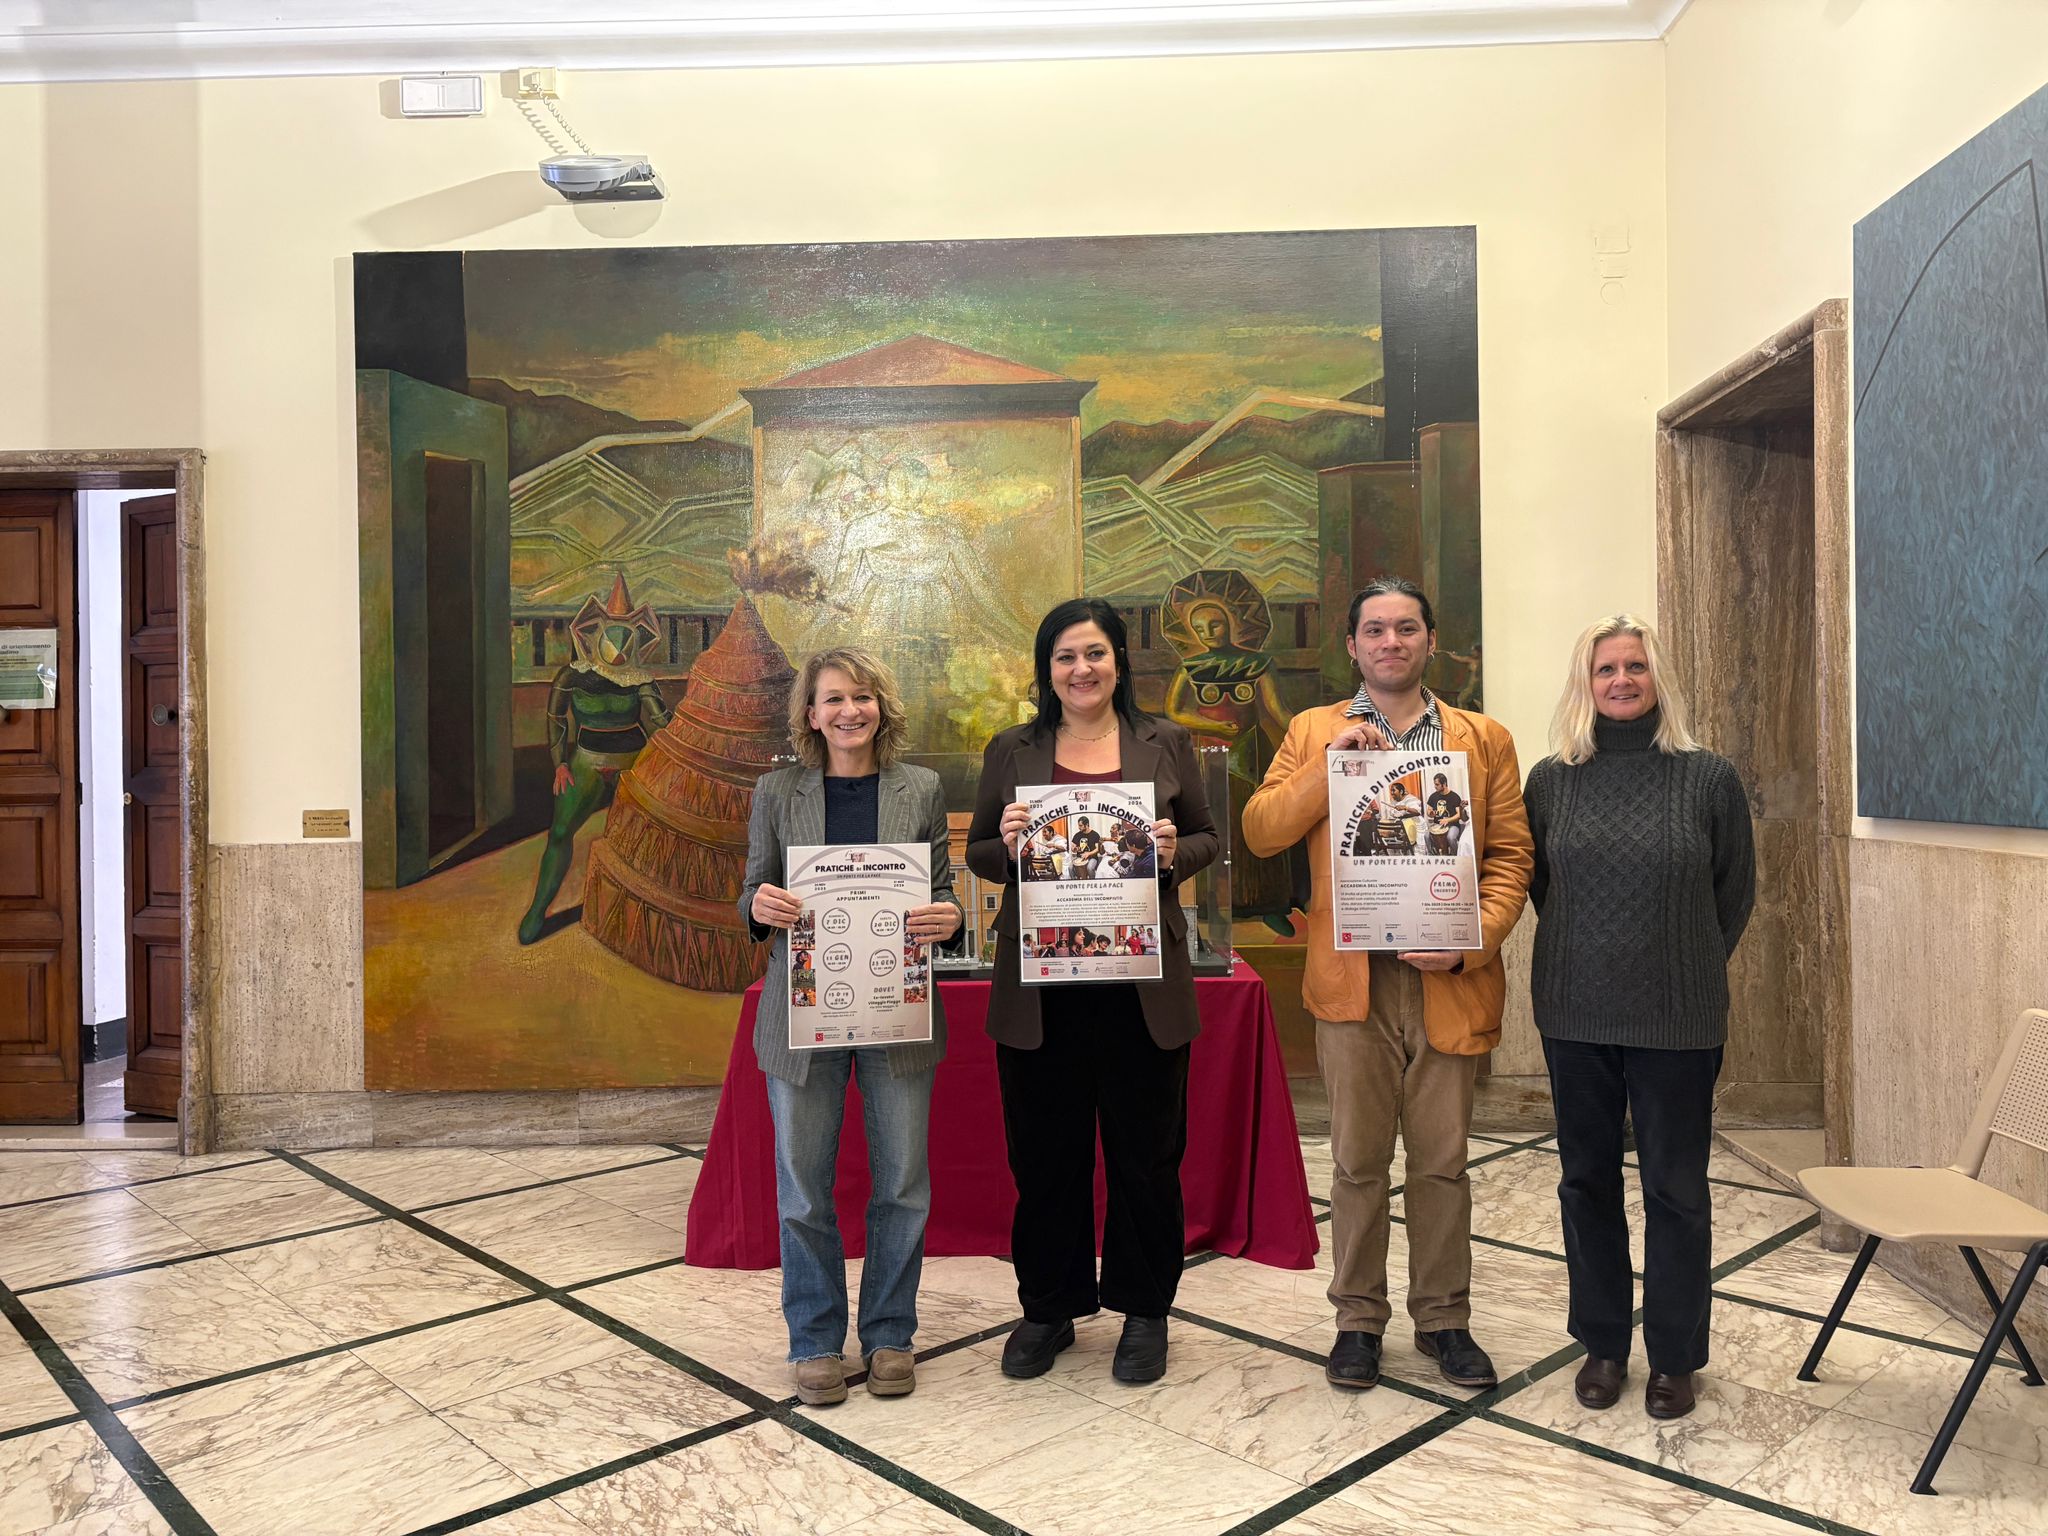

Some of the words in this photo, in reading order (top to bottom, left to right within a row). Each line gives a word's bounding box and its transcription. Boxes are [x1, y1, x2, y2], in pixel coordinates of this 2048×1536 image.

[1022, 805, 1070, 838] PRATICHE
[1098, 803, 1151, 833] INCONTRO
[1340, 794, 1371, 857] PRATICHE
[1370, 780, 1384, 794] DI
[1384, 755, 1451, 782] INCONTRO
